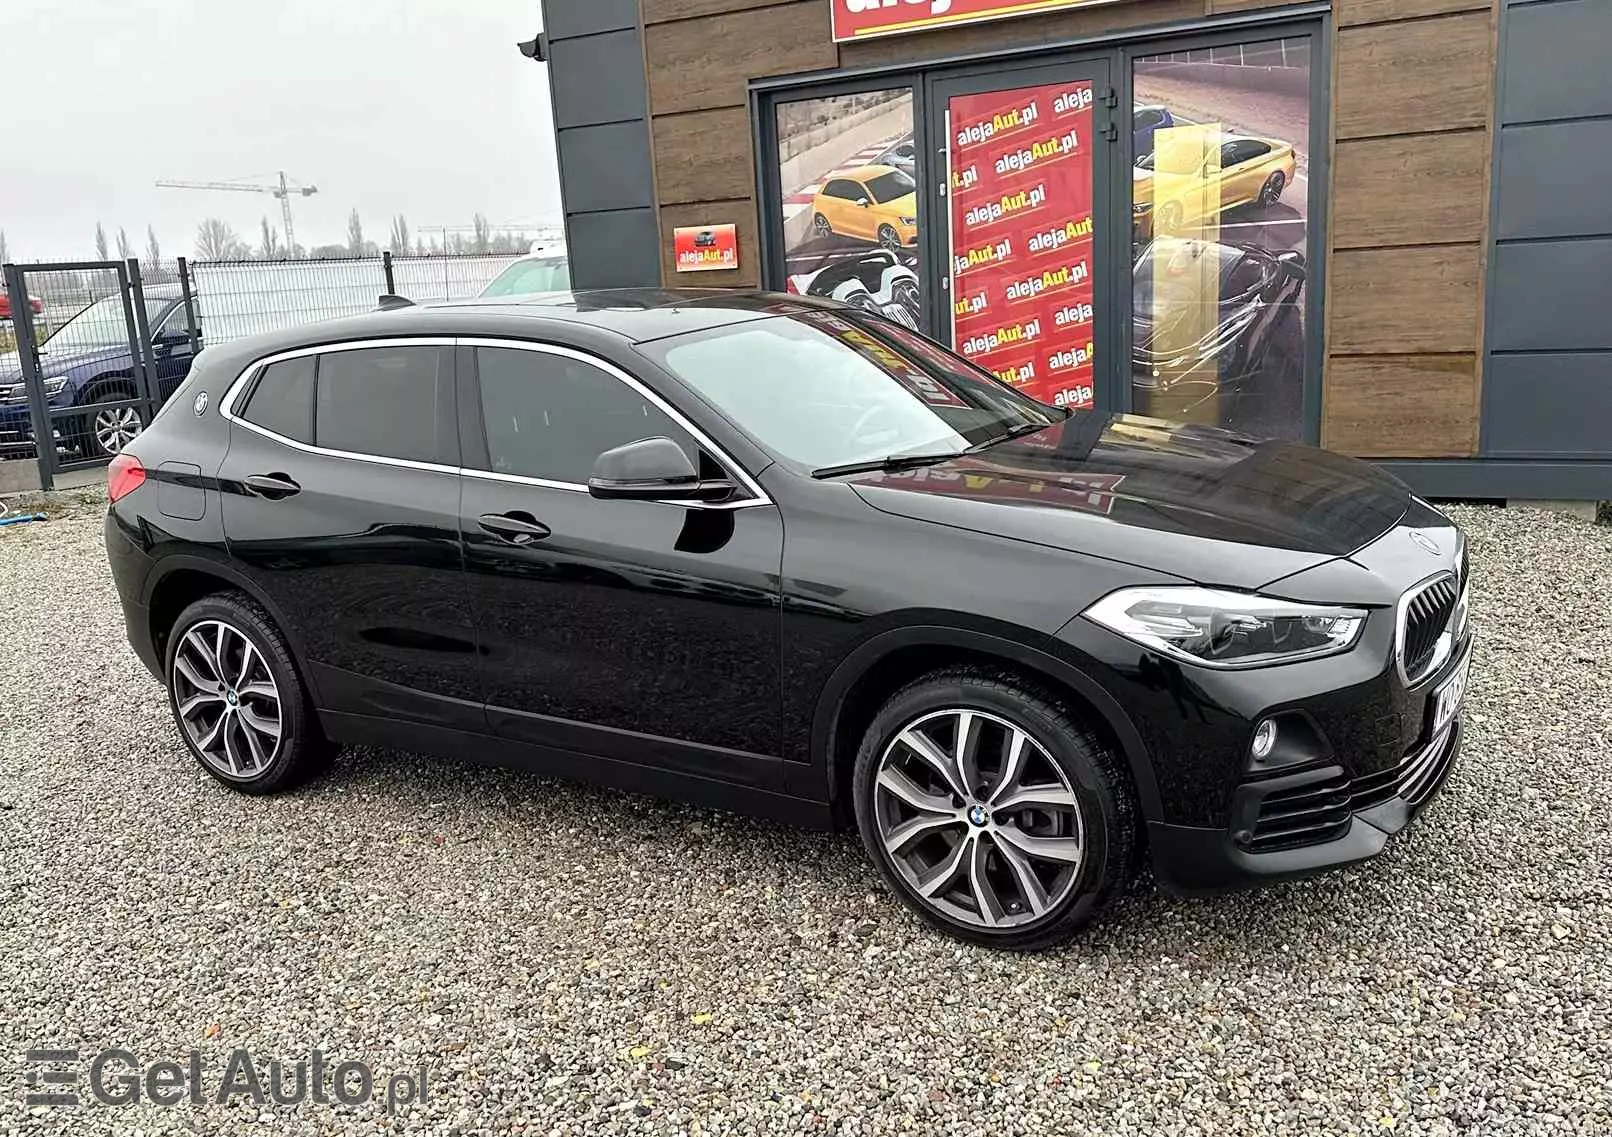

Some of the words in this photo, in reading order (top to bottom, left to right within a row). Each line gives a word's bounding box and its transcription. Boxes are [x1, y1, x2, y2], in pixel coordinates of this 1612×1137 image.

[957, 101, 1038, 146] alejaAut.pl
[995, 129, 1078, 174] alejaAut.pl
[964, 183, 1046, 225] alejaAut.pl
[679, 247, 733, 264] alejaAut.pl
[1006, 260, 1088, 300] alejaAut.pl
[962, 318, 1041, 355] alejaAut.pl
